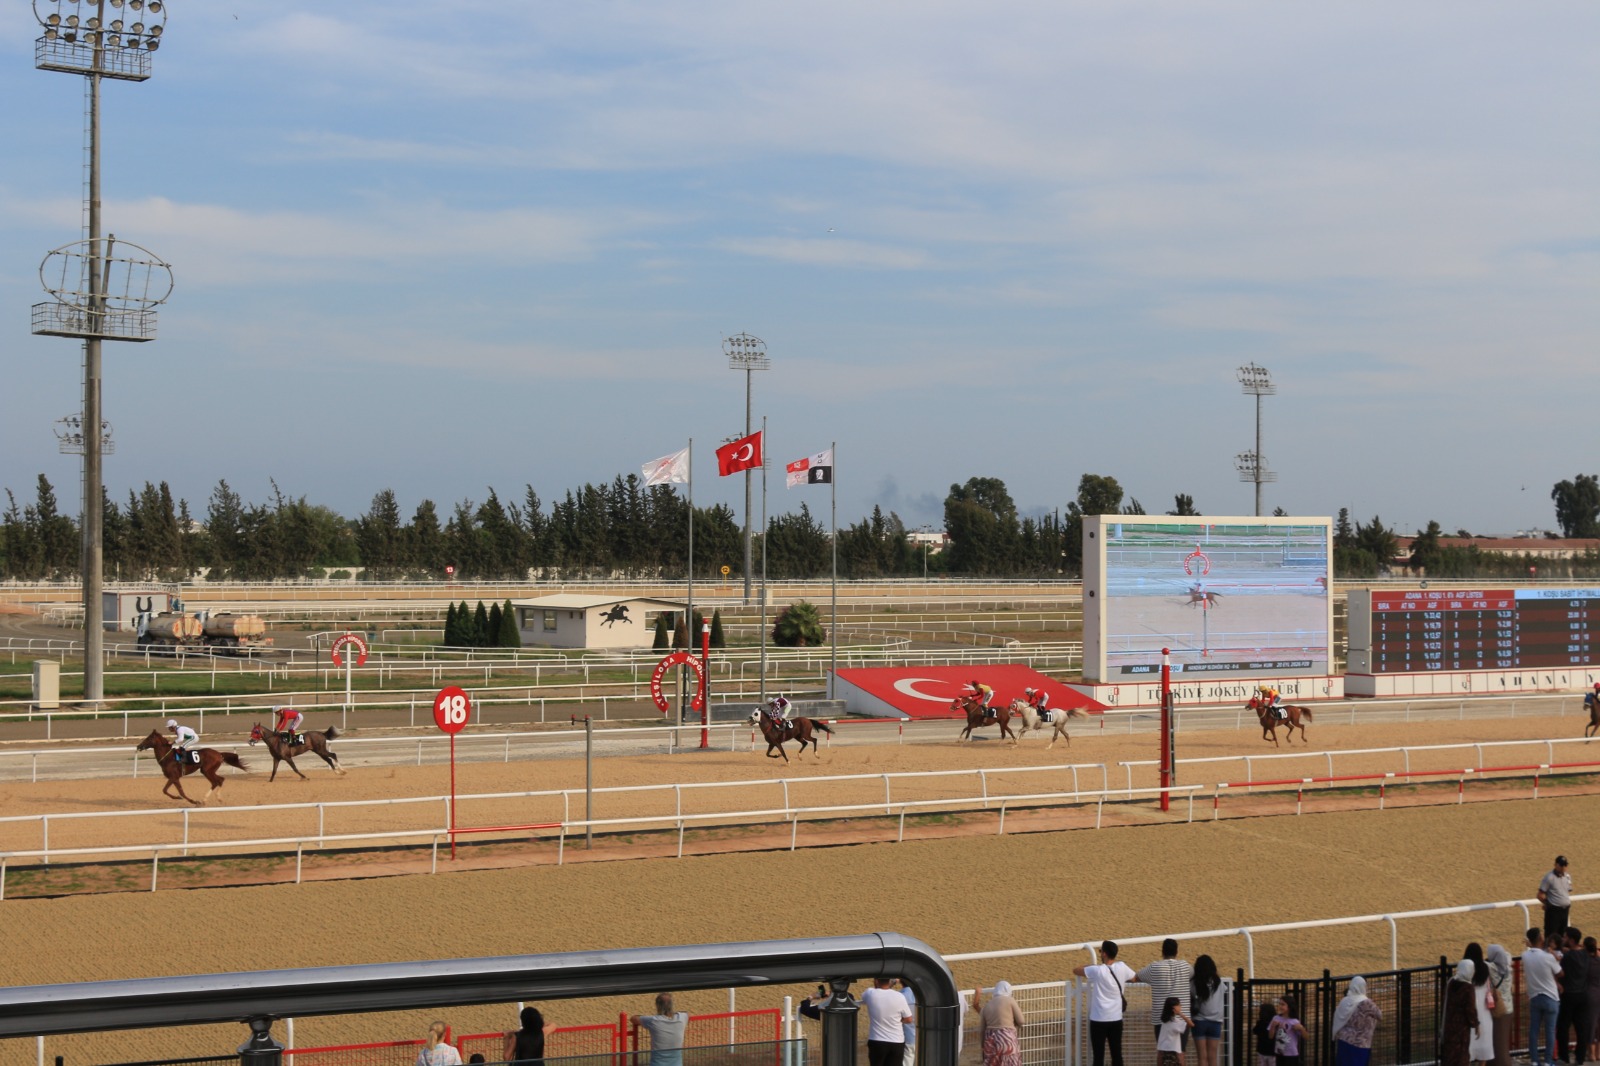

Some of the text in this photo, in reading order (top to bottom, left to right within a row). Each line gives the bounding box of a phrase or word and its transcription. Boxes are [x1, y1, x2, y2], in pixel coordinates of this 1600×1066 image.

[1405, 591, 1422, 599] ADANA
[1208, 685, 1248, 698] JOKEY
[1253, 681, 1302, 697] KÜBÜ
[439, 695, 466, 724] 18
[1279, 708, 1288, 719] 10
[1046, 711, 1053, 722] 11
[298, 734, 305, 744] 4
[192, 750, 200, 763] 6
